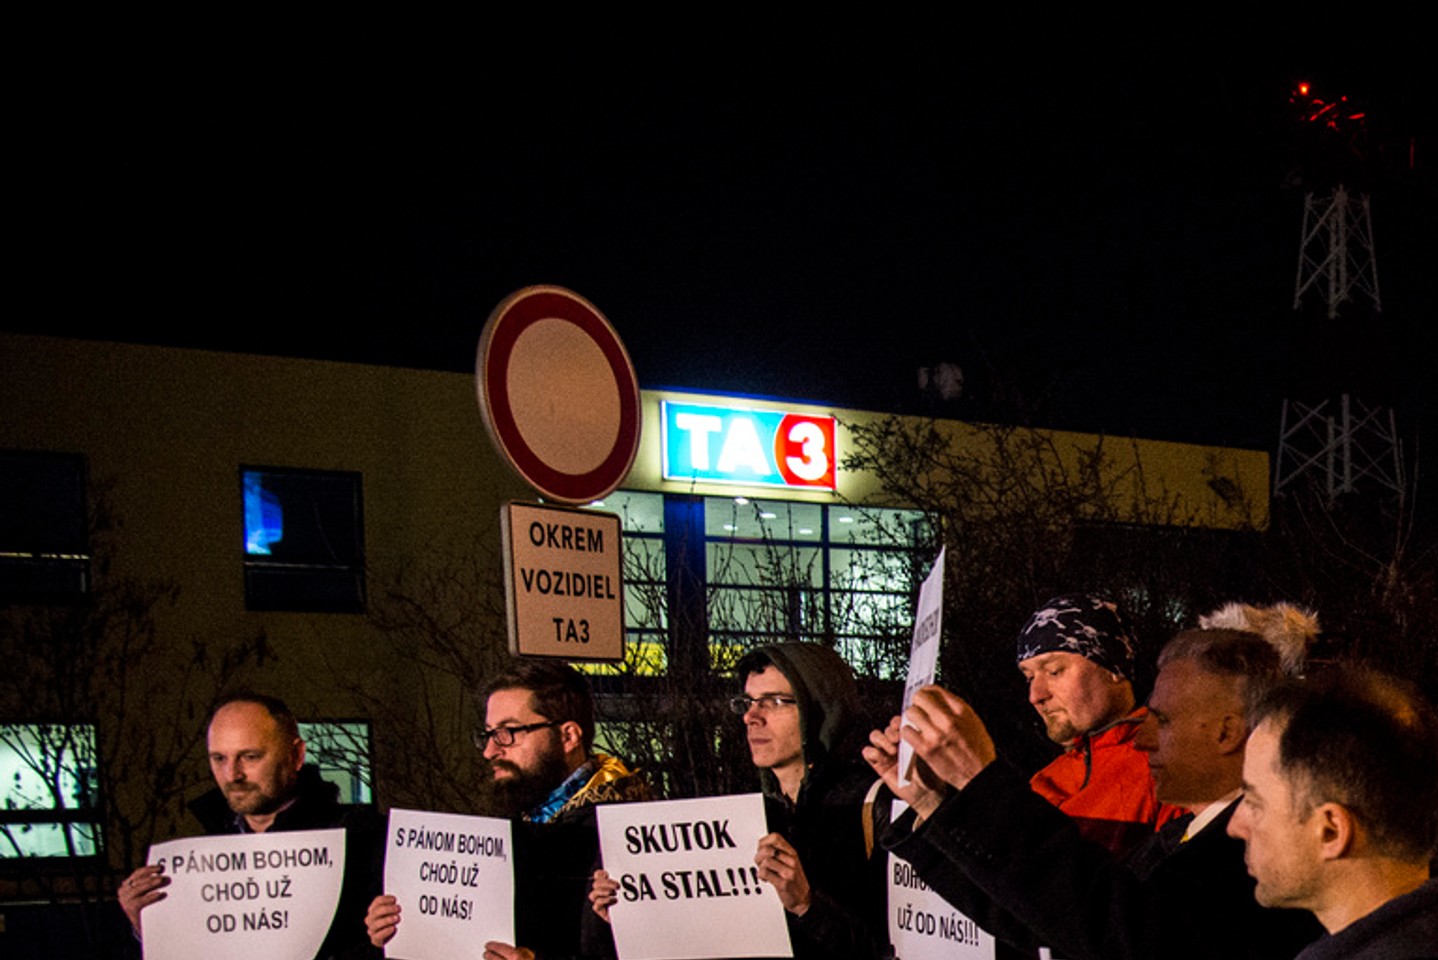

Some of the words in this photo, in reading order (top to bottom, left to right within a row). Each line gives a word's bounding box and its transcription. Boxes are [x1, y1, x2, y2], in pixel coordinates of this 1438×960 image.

[675, 411, 829, 481] TA3
[529, 521, 604, 553] OKREM
[520, 567, 616, 600] VOZIDIEL
[552, 617, 590, 643] TA3
[396, 827, 406, 847] S
[407, 825, 456, 852] PÁNOM
[457, 833, 507, 862] BOHOM,
[625, 819, 737, 855] SKUTOK
[172, 850, 247, 874] PÁNOM
[253, 847, 333, 870] BOHOM,
[419, 860, 459, 885] CHOĎ
[461, 863, 480, 888] UŽ
[201, 876, 260, 902] CHOĎ
[265, 875, 293, 899] UŽ
[620, 873, 658, 902] SA
[661, 866, 763, 900] STAL!!!
[206, 914, 237, 934] OD
[242, 907, 289, 932] NÁS!
[418, 895, 438, 915] OD
[441, 894, 474, 921] NÁS!
[897, 903, 914, 932] UŽ
[915, 911, 936, 936] OD
[938, 912, 980, 947] NÁS!!!
